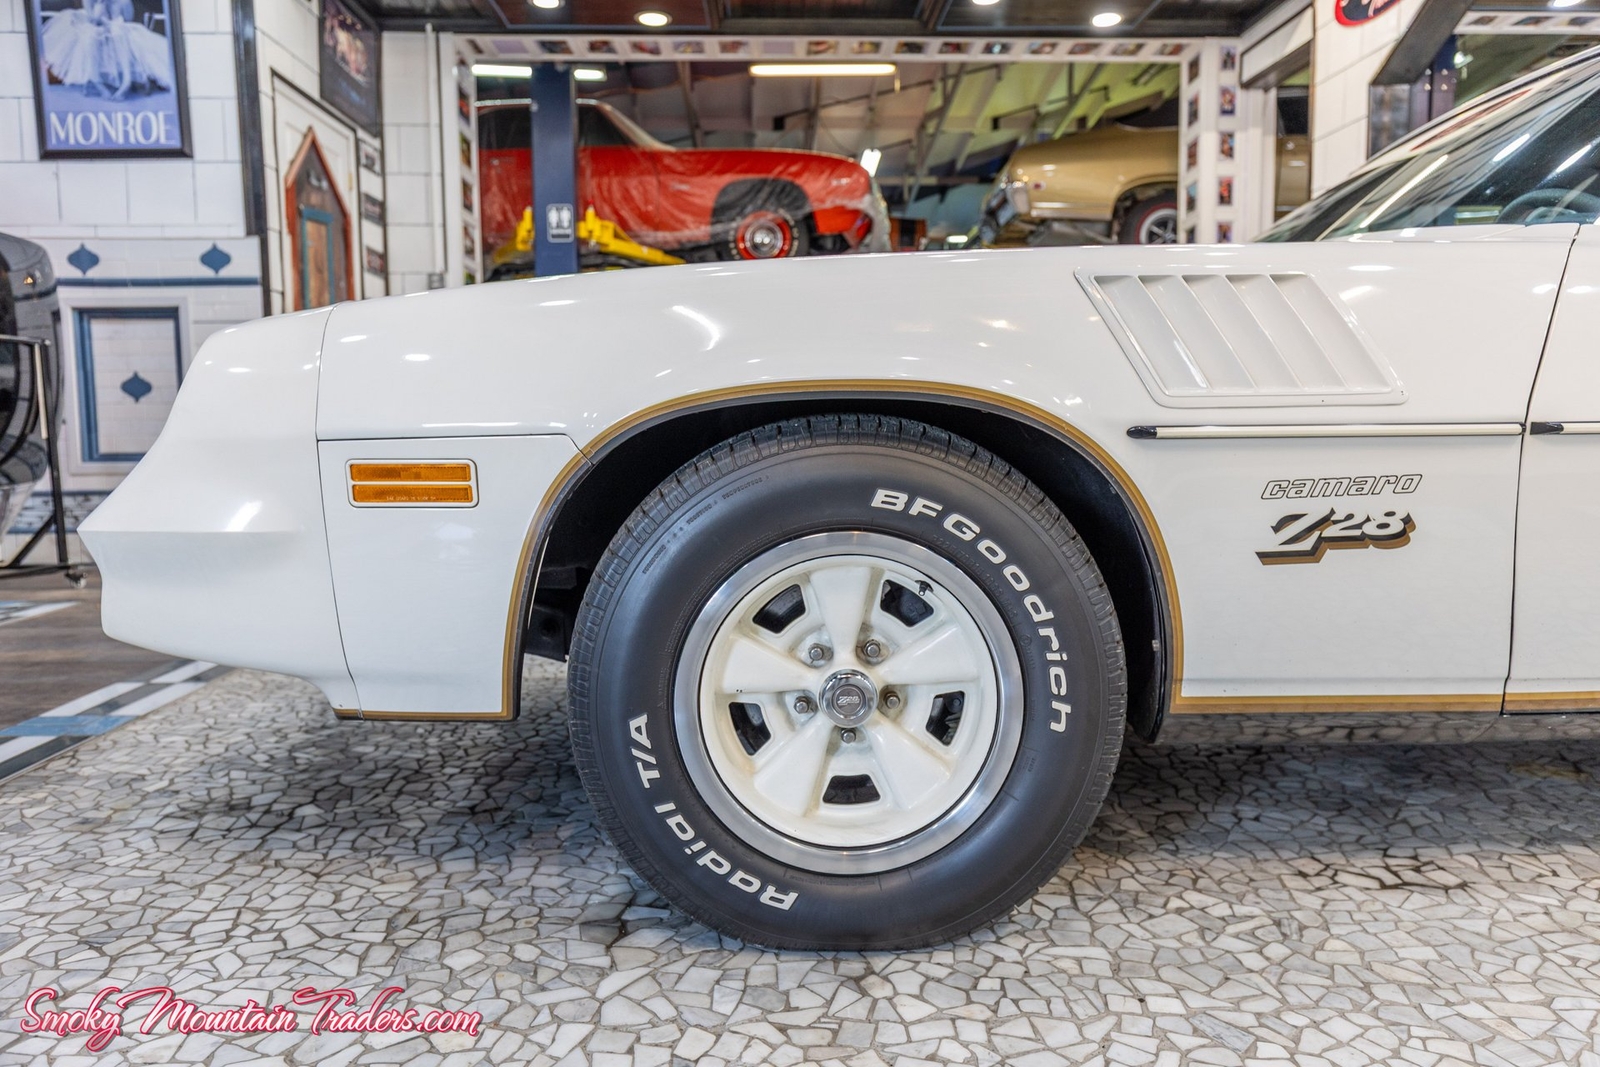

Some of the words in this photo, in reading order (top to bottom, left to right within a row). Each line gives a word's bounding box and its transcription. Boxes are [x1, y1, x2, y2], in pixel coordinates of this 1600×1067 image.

[49, 111, 176, 146] MONROE
[1261, 474, 1423, 500] camaro
[1254, 507, 1417, 566] Z28
[870, 489, 1072, 733] BFGoodrich
[629, 714, 661, 789] T/A
[654, 802, 799, 911] Radial
